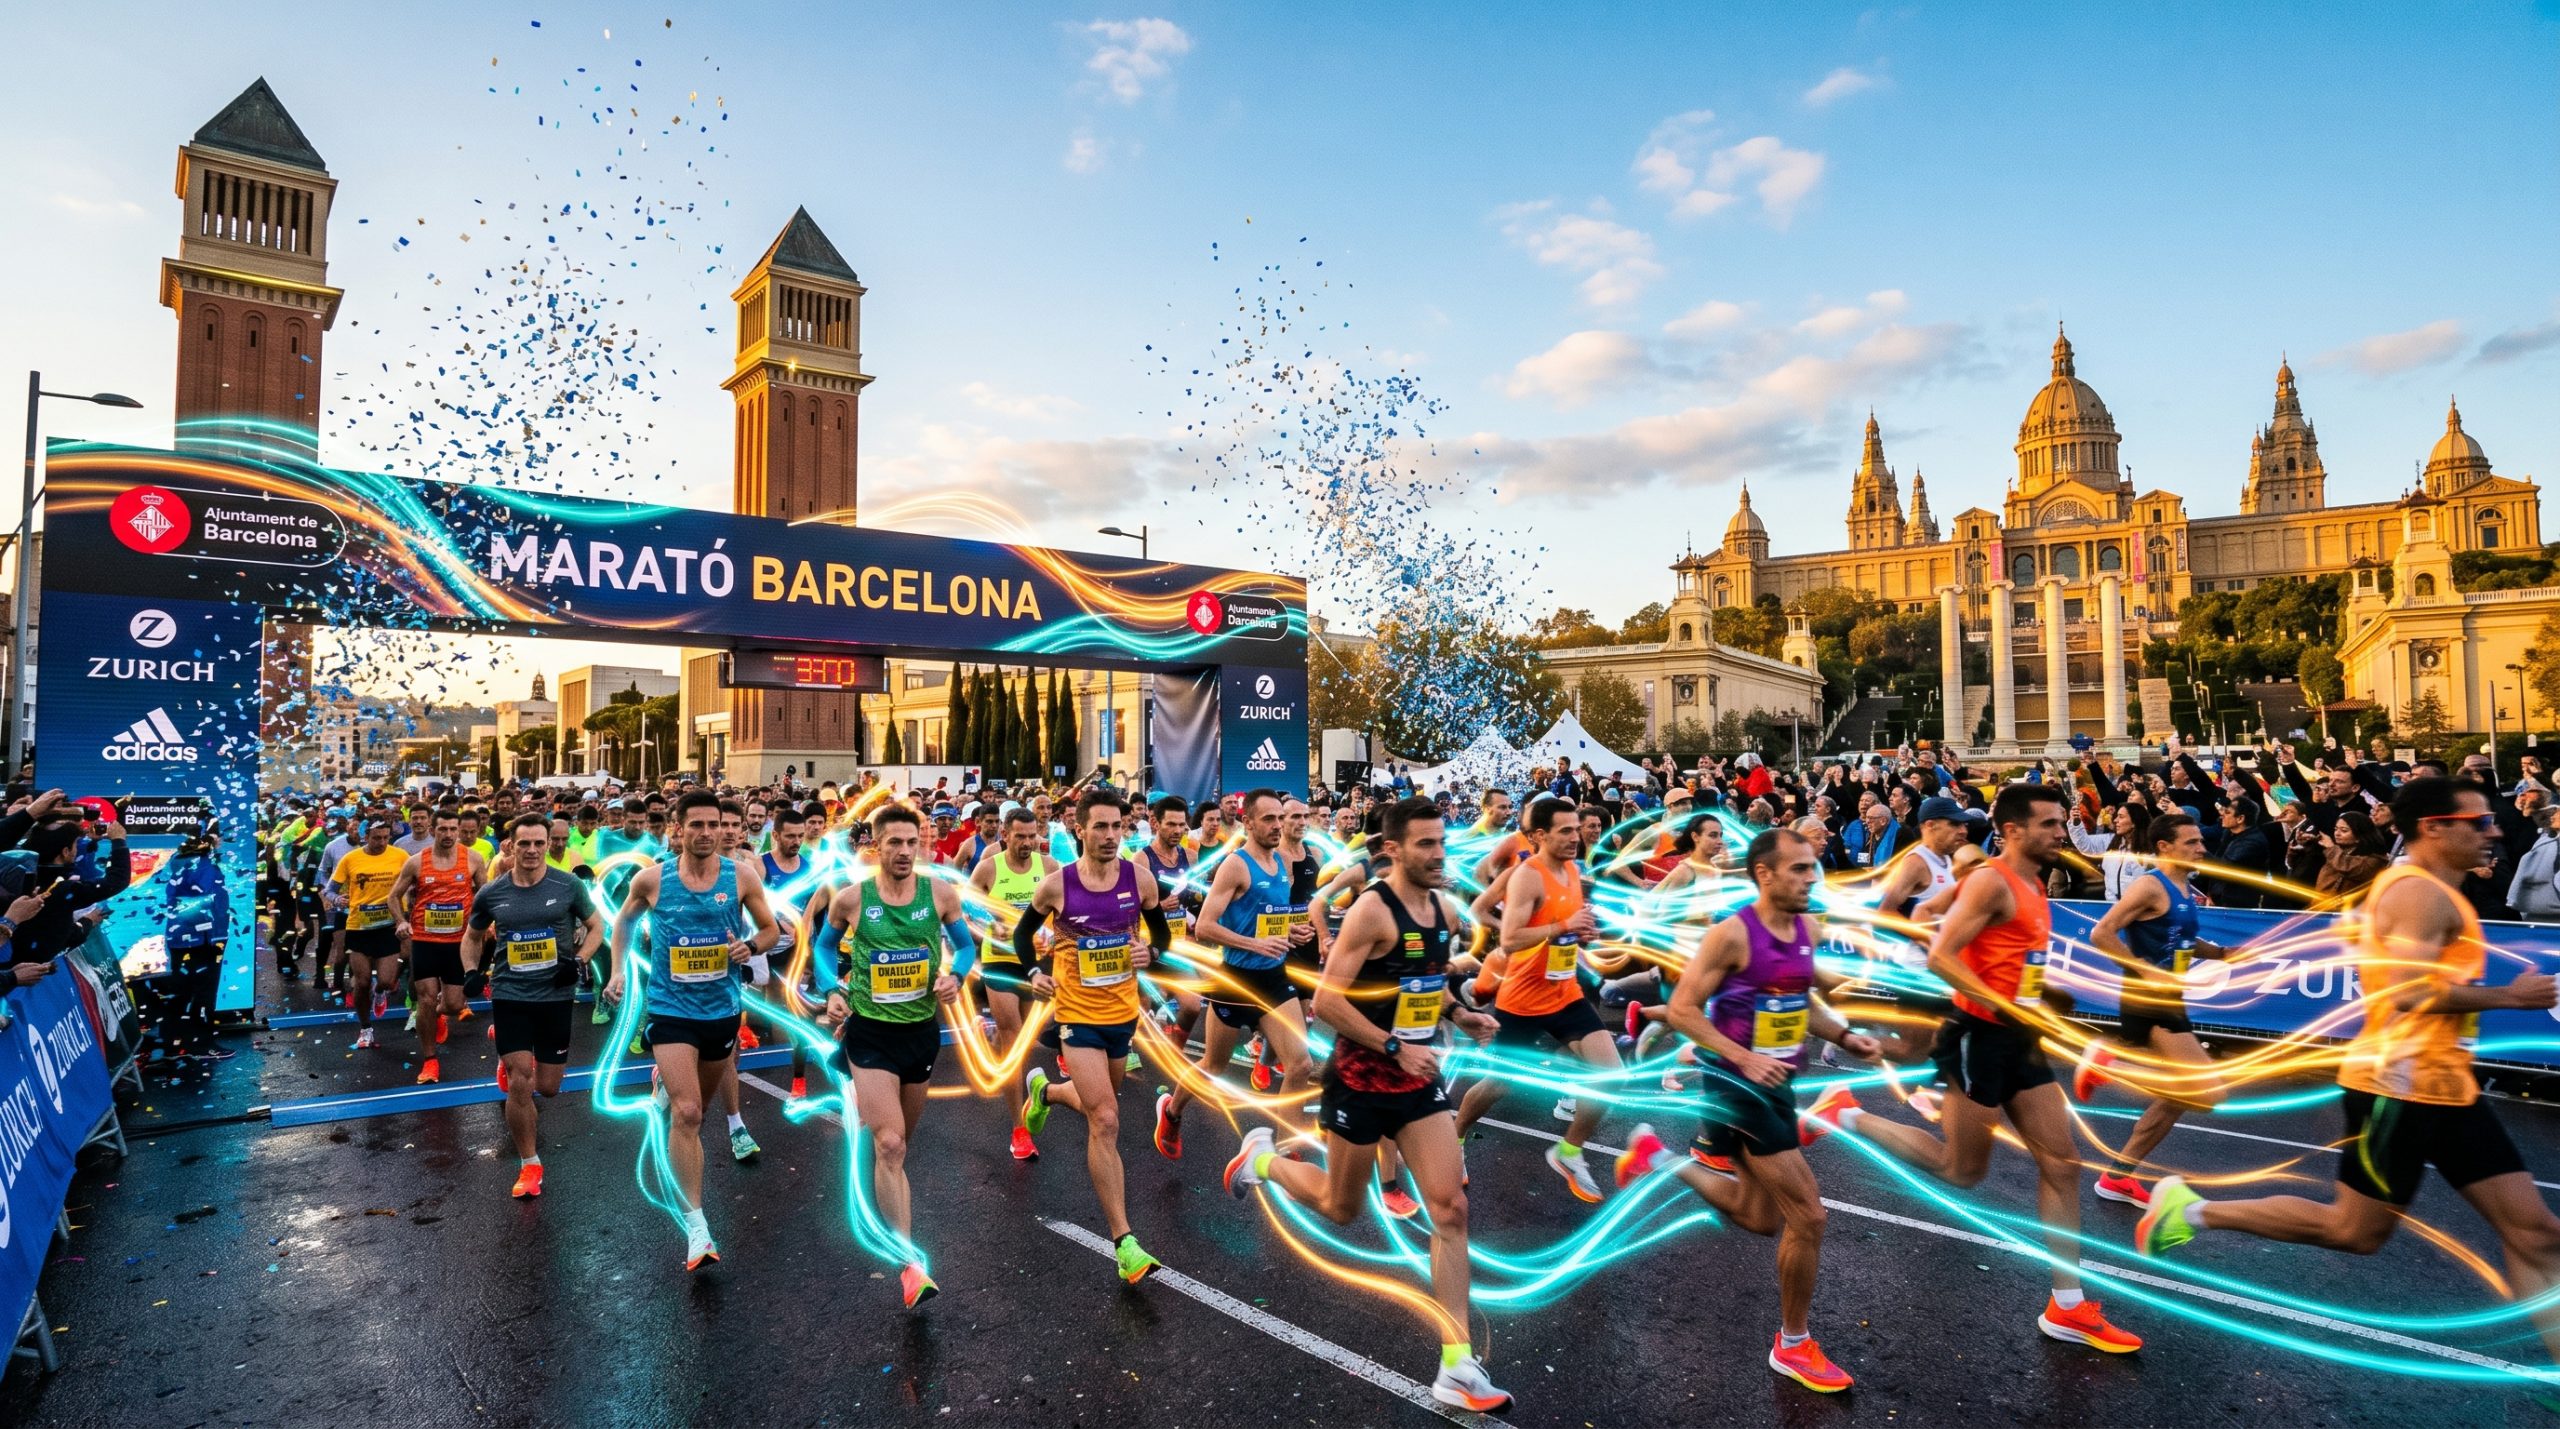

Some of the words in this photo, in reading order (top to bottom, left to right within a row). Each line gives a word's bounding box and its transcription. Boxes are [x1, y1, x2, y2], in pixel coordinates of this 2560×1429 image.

[204, 507, 295, 528] Ajuntament
[298, 514, 318, 528] de
[204, 523, 318, 549] Barcelona
[490, 531, 735, 598] MARATÓ
[752, 555, 1043, 621] BARCELONA
[86, 657, 216, 682] ZURICH
[1239, 705, 1291, 720] ZURICH
[101, 741, 199, 762] adidas
[1246, 758, 1287, 771] adidas
[125, 804, 185, 814] Ajuntament
[2254, 958, 2366, 1001] ZUR
[46, 1005, 92, 1080] ZURICH
